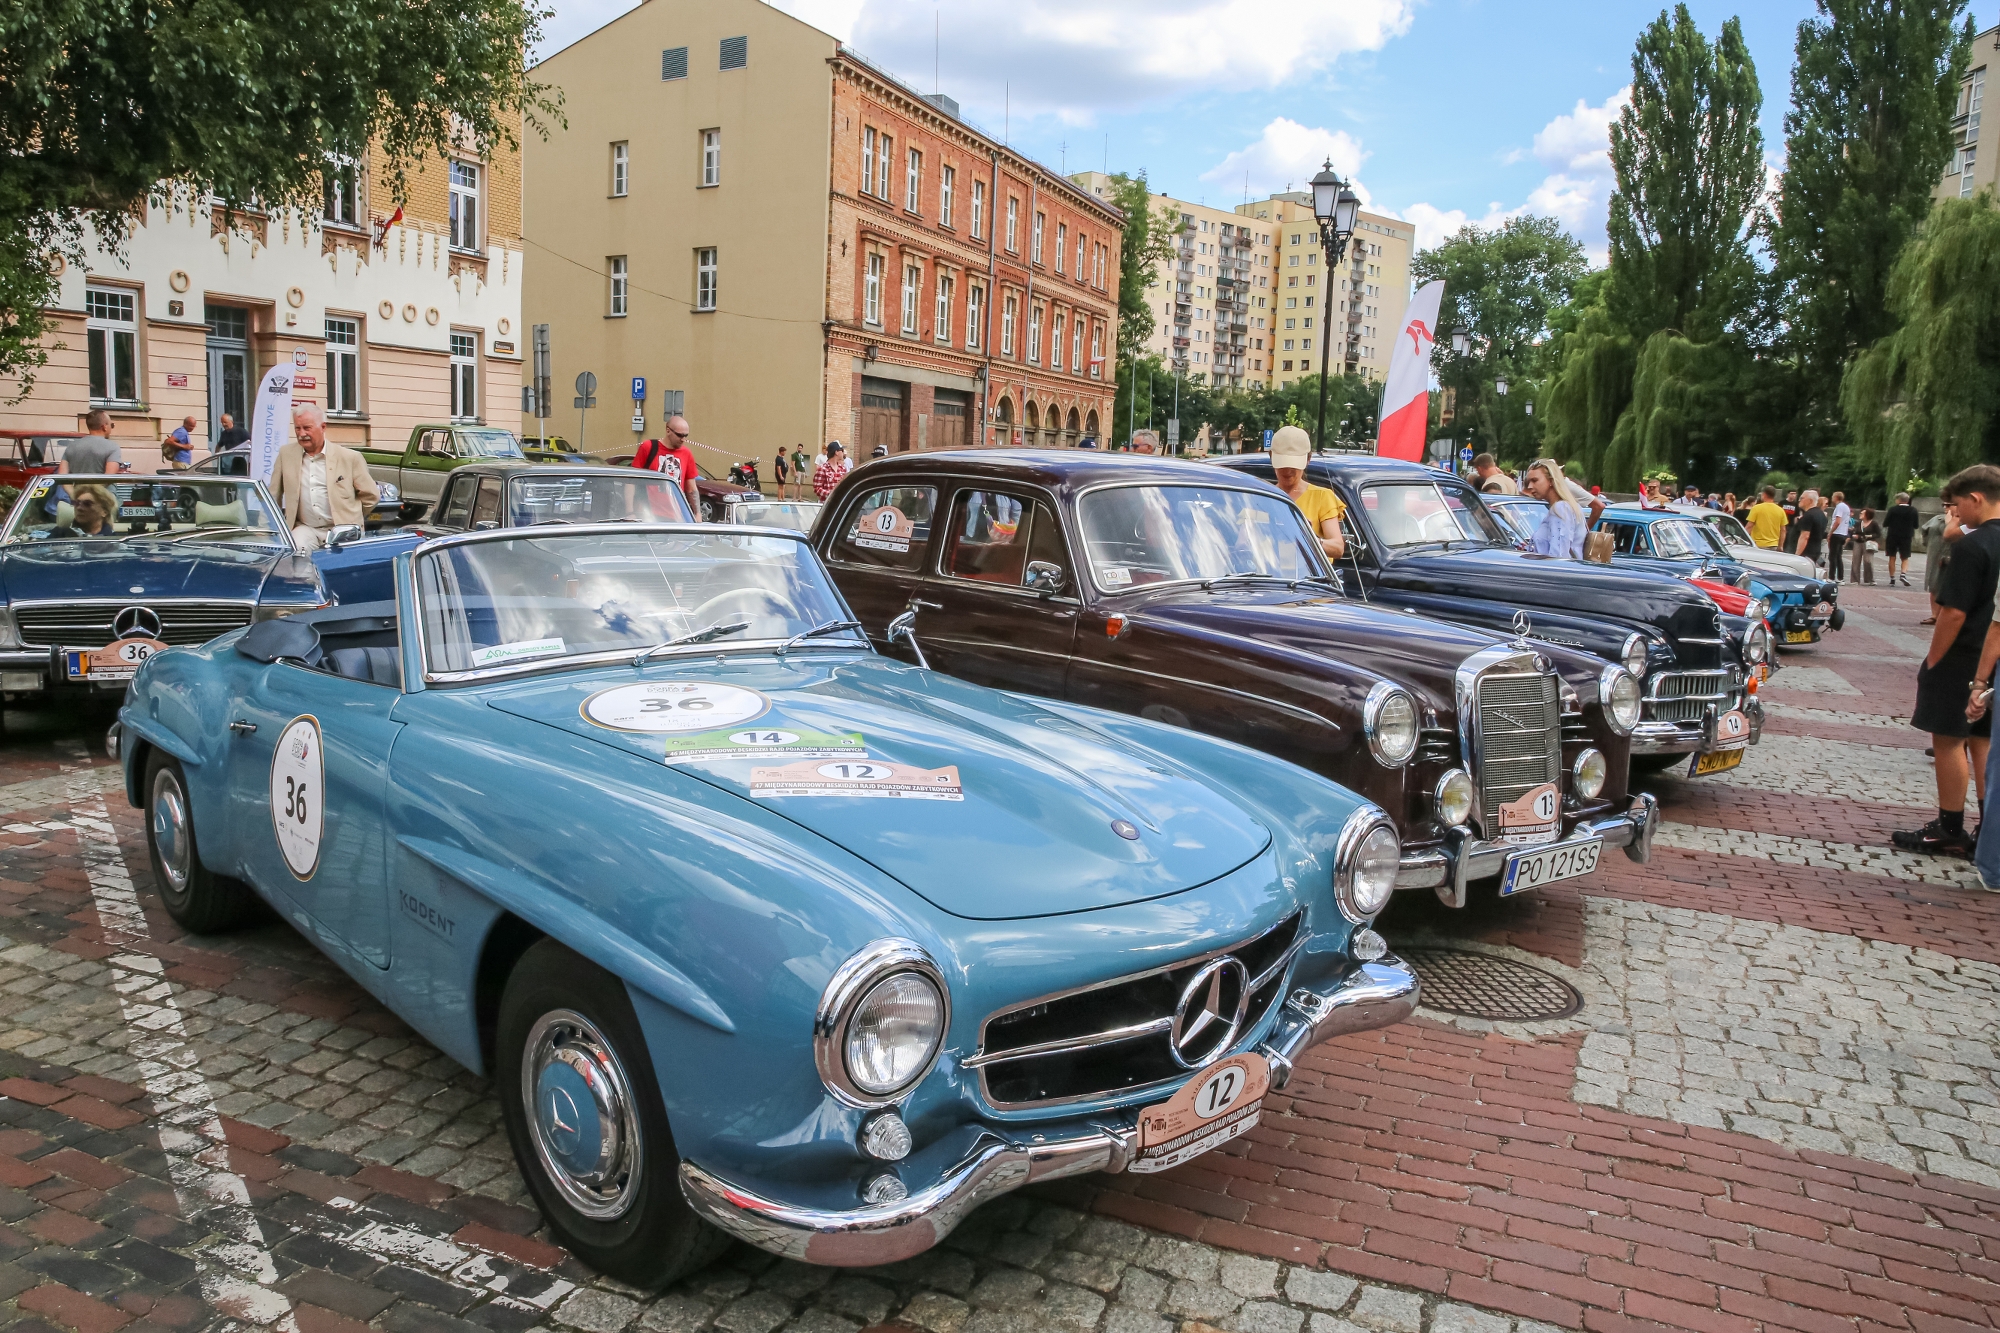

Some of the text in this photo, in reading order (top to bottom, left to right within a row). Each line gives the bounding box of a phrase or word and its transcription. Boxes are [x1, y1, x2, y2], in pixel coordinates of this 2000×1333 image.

[174, 306, 180, 314] 7
[634, 379, 643, 393] P
[264, 404, 275, 475] AUTOMOTIVE
[123, 508, 134, 516] SB
[881, 514, 893, 530] 13
[128, 645, 147, 660] 36
[639, 697, 714, 712] 36
[1728, 718, 1739, 732] 14
[743, 732, 783, 744] 14
[679, 748, 737, 756] MIĘDZYNARODOWY
[834, 764, 875, 779] 12
[877, 783, 912, 791] POJAZDÓW
[285, 775, 307, 824] 36
[1541, 794, 1553, 815] 13
[1516, 845, 1598, 887] PO 121SS
[399, 889, 456, 936] KODENT
[1208, 1072, 1235, 1111] 12
[1148, 1132, 1193, 1158] MIĘDZYNARODOWY
[1193, 1121, 1216, 1140] BESKIDZKI
[1215, 1116, 1228, 1131] RAJD
[1227, 1105, 1249, 1123] POJAZDÓW
